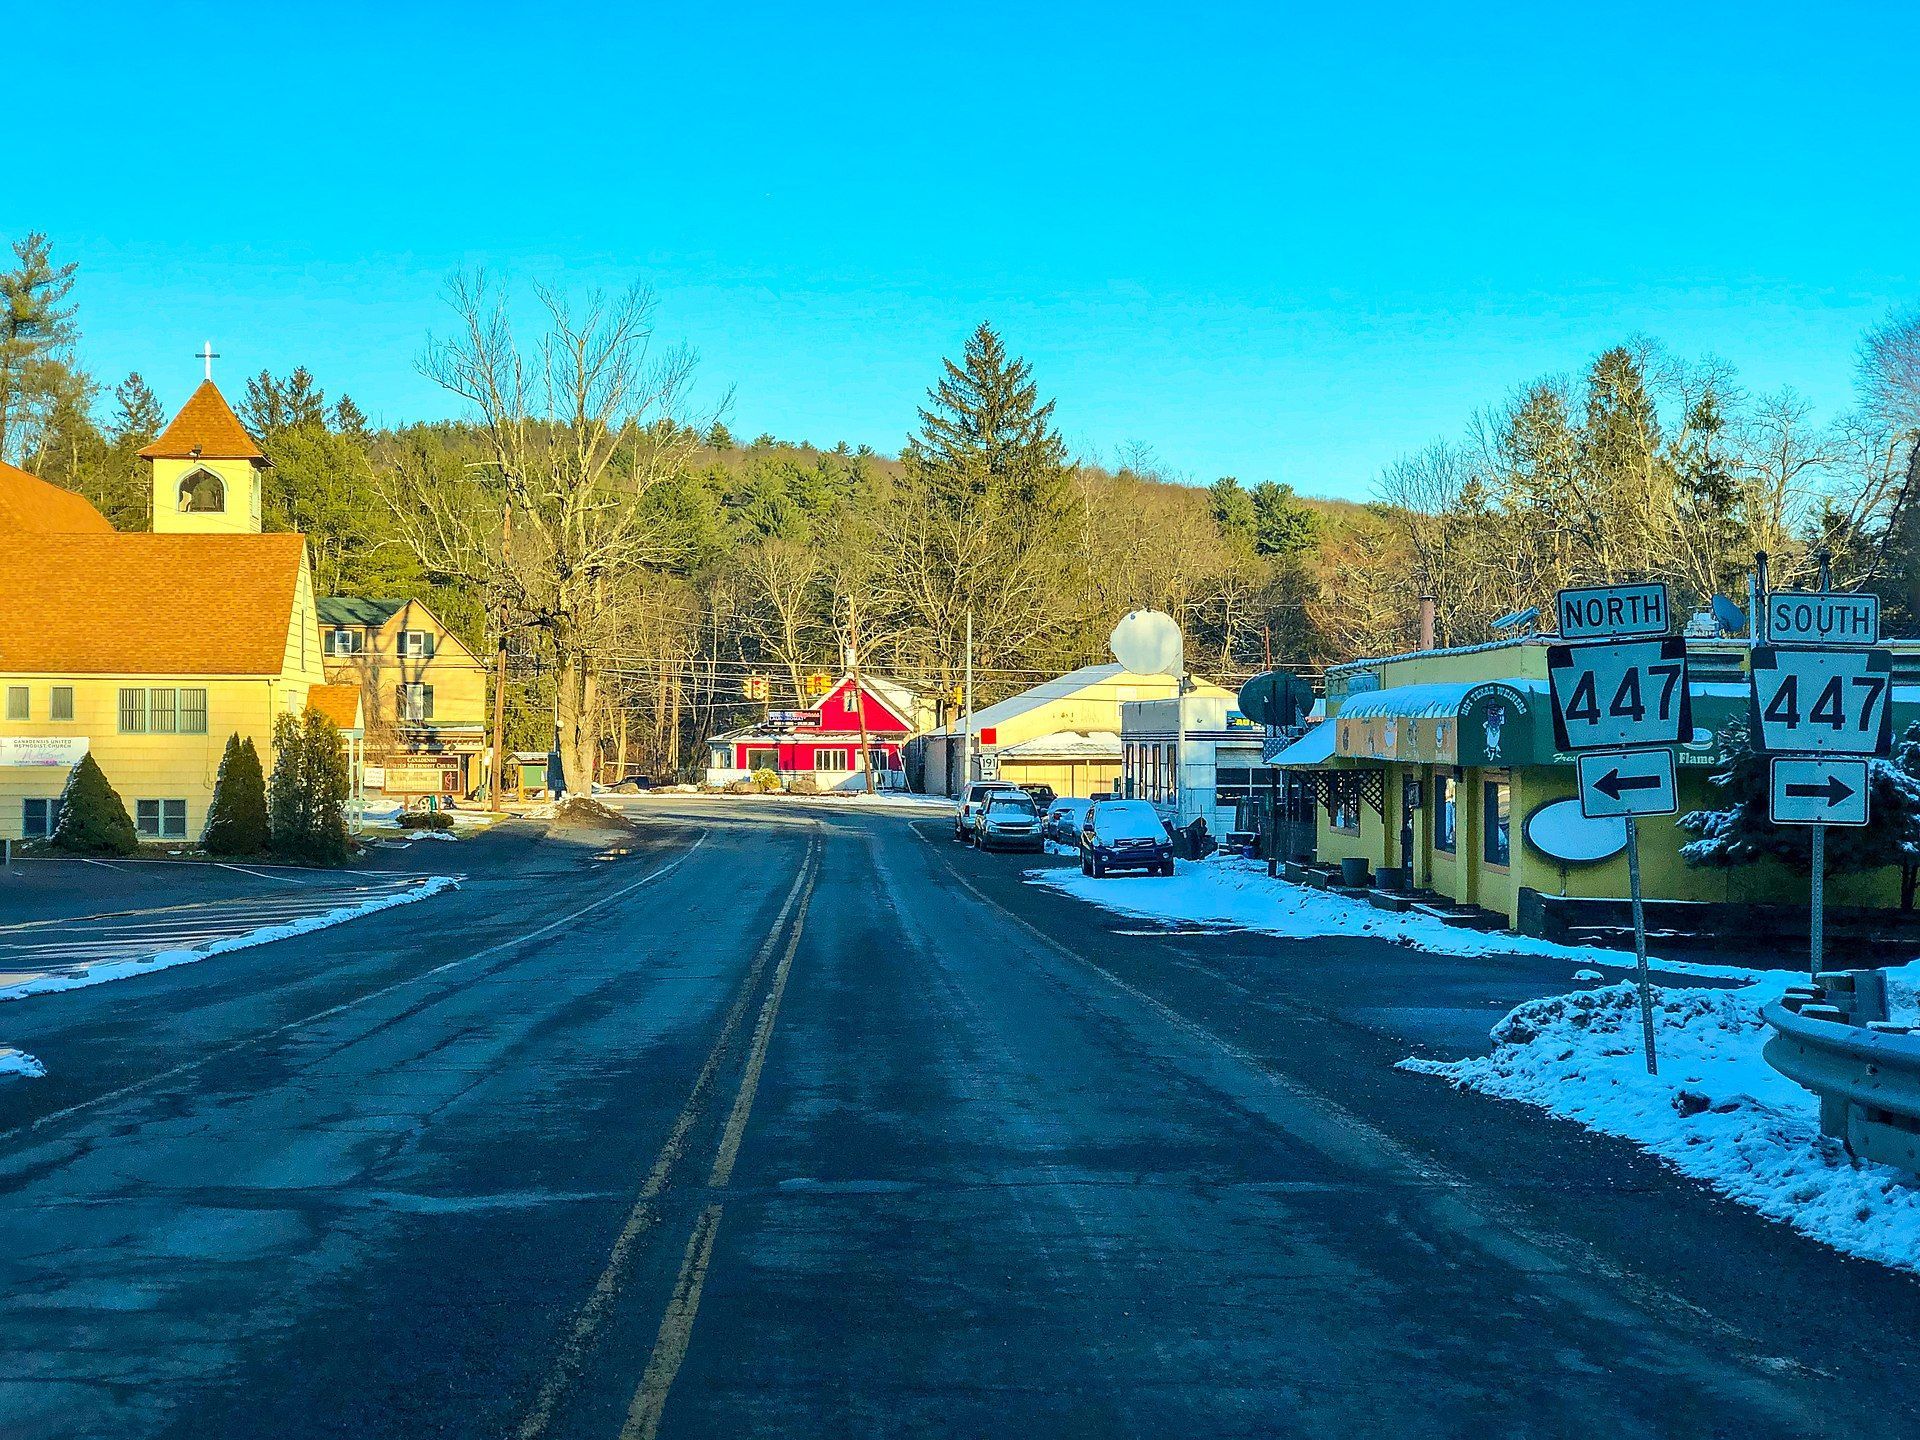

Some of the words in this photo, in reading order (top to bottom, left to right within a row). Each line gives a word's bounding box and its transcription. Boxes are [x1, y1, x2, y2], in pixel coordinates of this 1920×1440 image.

[1565, 594, 1661, 629] NORTH
[1775, 603, 1869, 635] SOUTH
[1461, 699, 1473, 716] HOT
[1565, 664, 1681, 725] 447
[1763, 674, 1886, 732] 447
[982, 758, 996, 768] 191
[1552, 753, 1576, 763] Fres
[1679, 753, 1715, 764] Flame
